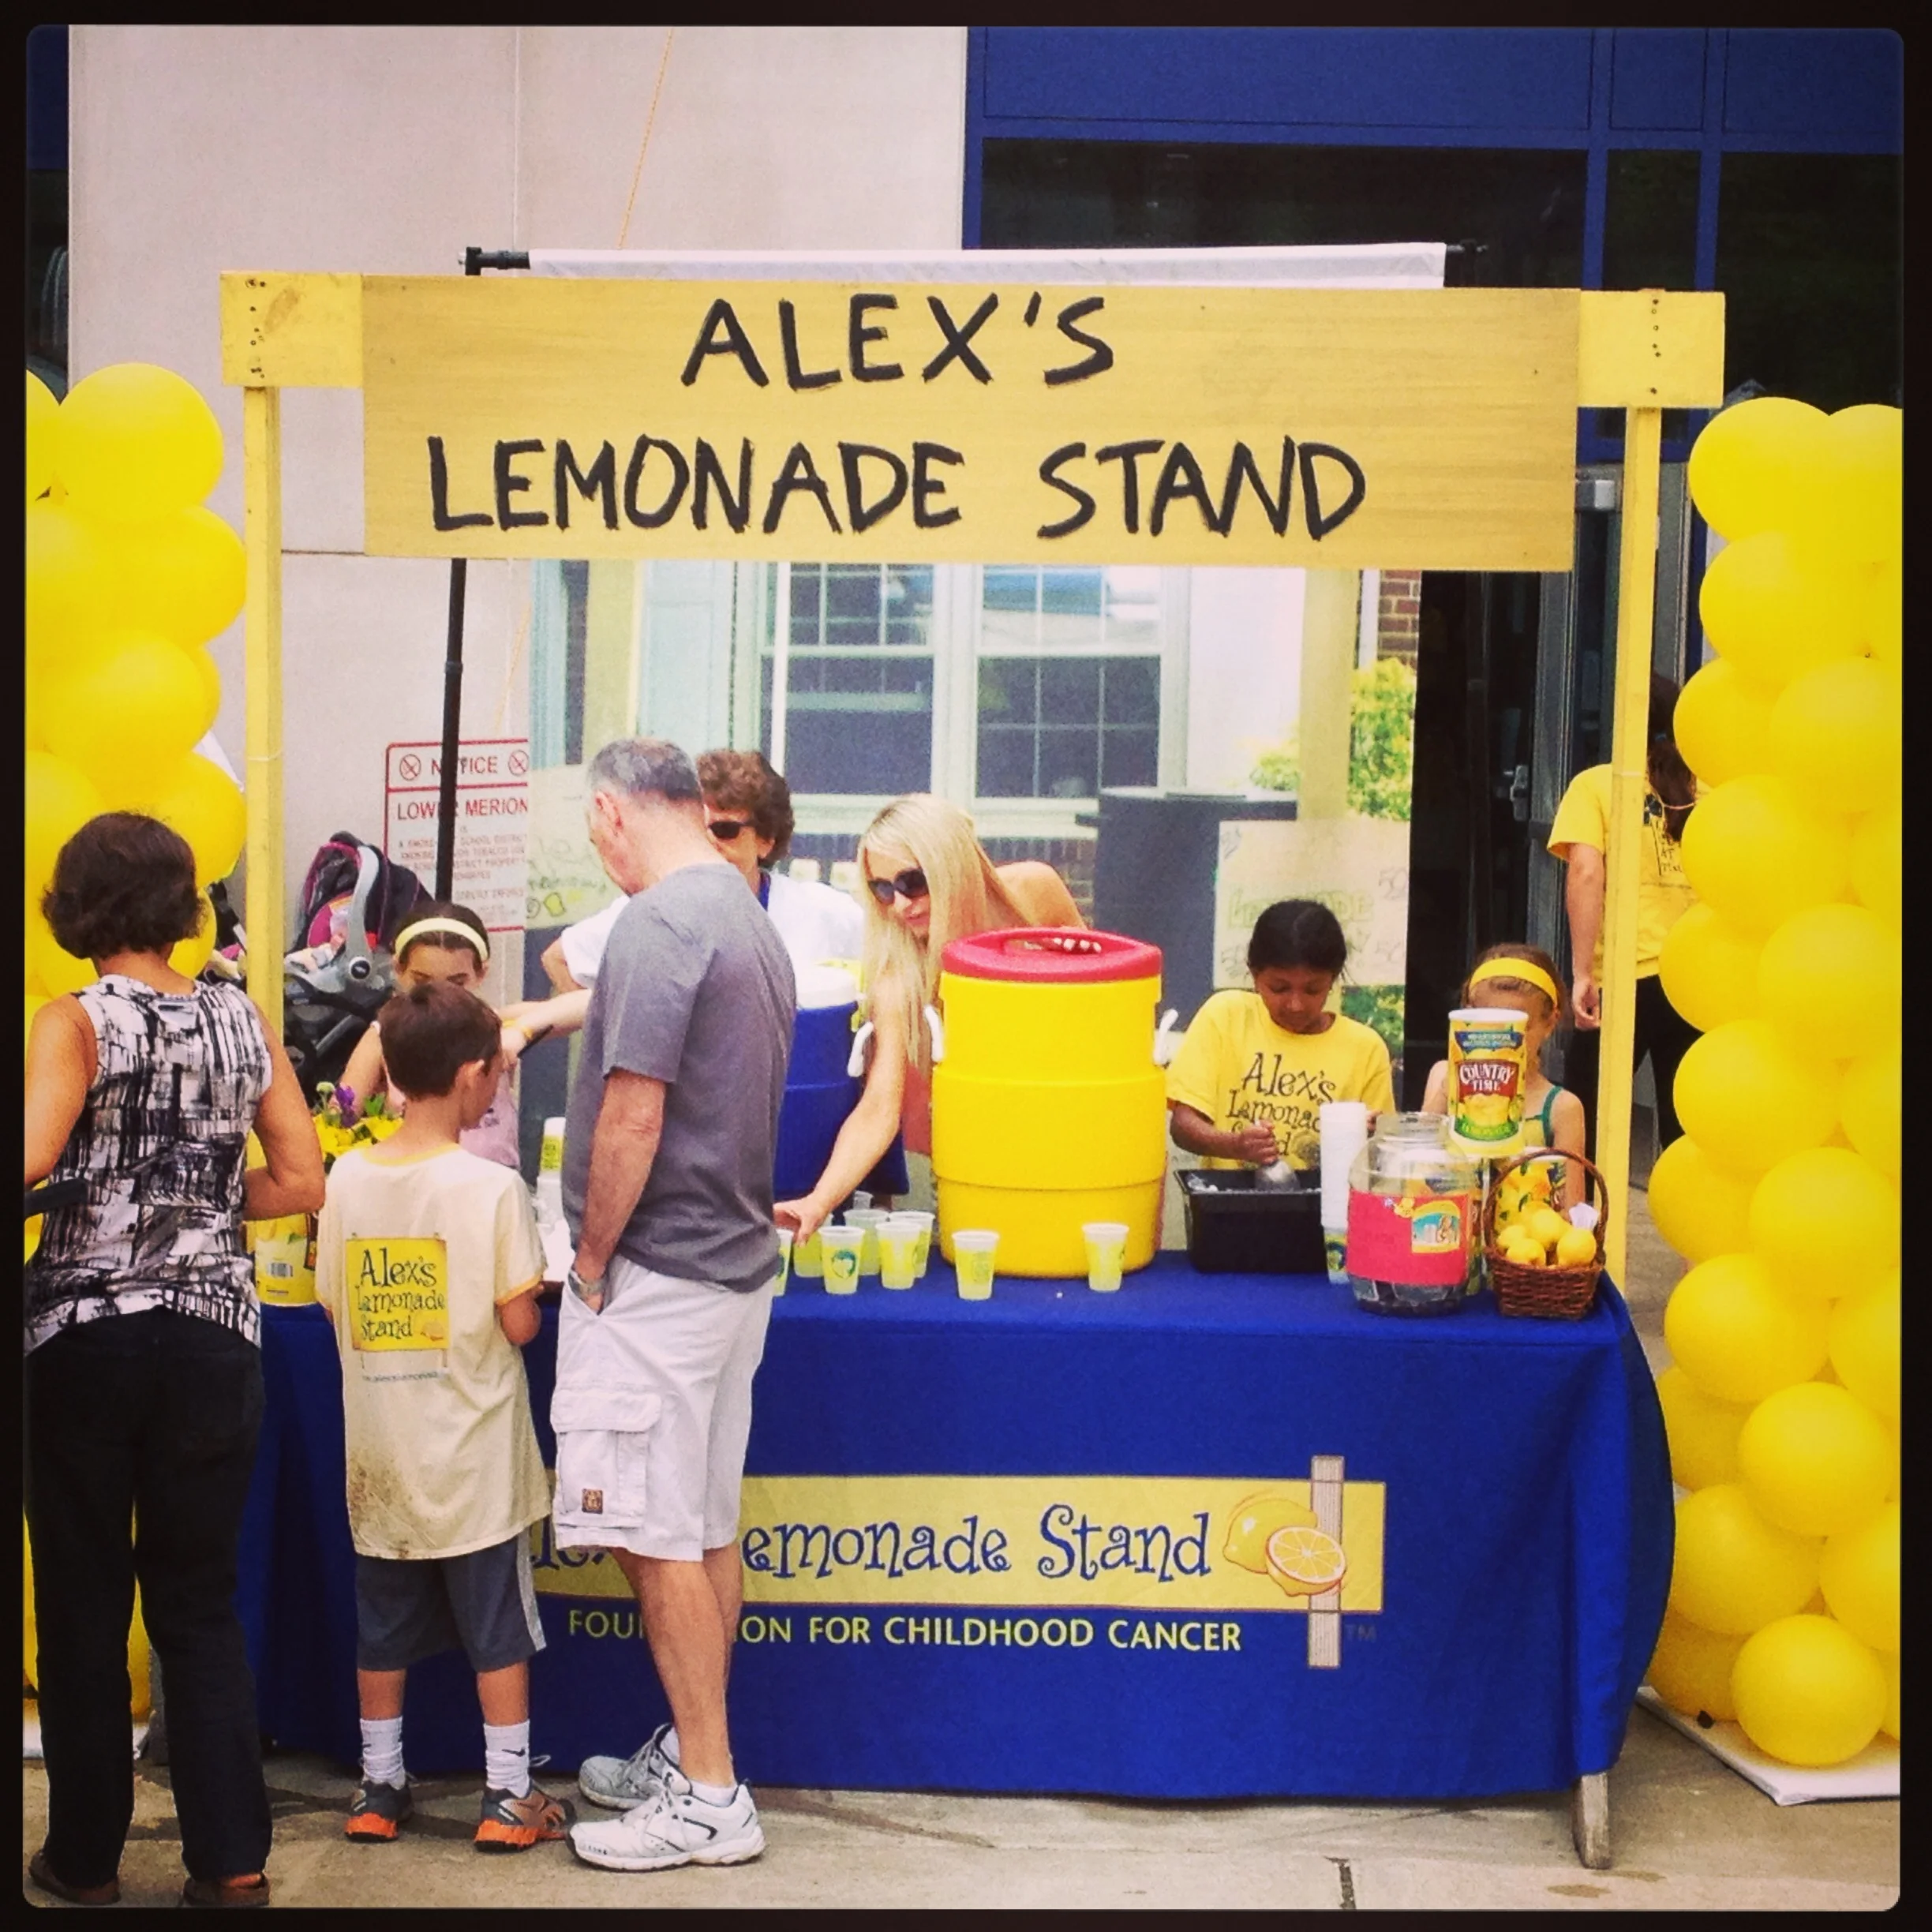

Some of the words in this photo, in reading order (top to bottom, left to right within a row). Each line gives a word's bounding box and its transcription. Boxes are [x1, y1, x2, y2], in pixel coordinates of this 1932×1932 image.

[681, 290, 1114, 391] ALEX'S
[428, 433, 964, 534] LEMONADE
[1036, 435, 1366, 541] STAND
[431, 755, 499, 776] NTICE
[397, 800, 459, 821] LOW
[466, 797, 528, 817] MERION
[1241, 1051, 1336, 1106] Alex's
[1459, 1063, 1515, 1085] COUNTRY
[1473, 1079, 1501, 1091] TIME
[1225, 1089, 1320, 1133] Lemona
[360, 1247, 437, 1288] Alex's
[354, 1284, 446, 1314] Lemonade
[741, 1515, 1012, 1578] emonade
[1037, 1503, 1211, 1582] Stand
[809, 1616, 871, 1644] FOR
[884, 1616, 1094, 1647] CHILDHOOD
[1107, 1620, 1241, 1652] CANCER
